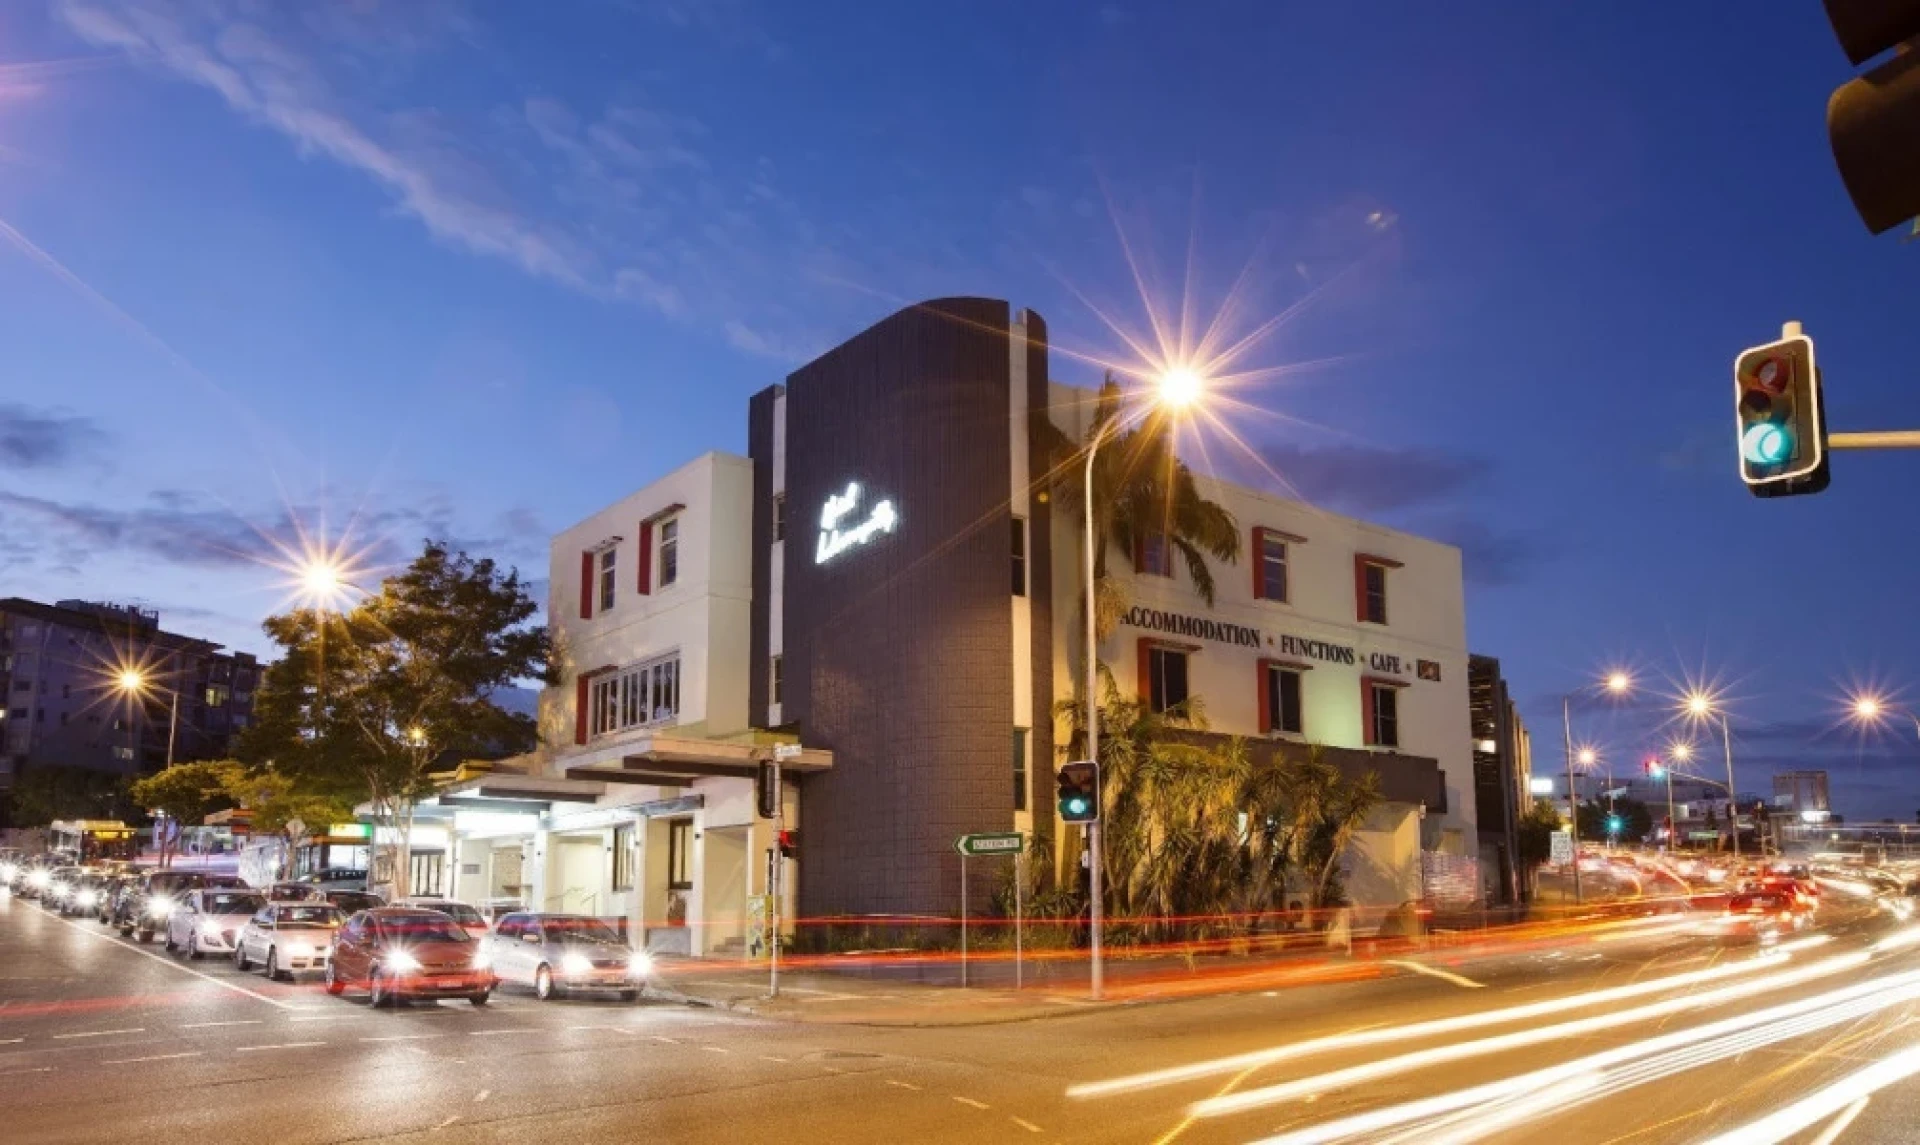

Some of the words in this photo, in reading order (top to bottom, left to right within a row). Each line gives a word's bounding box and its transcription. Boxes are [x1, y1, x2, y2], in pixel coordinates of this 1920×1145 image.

[1119, 606, 1260, 648] ACCOMMODATION
[1281, 635, 1355, 665] FUNCTIONS
[1370, 652, 1401, 675] CAFE
